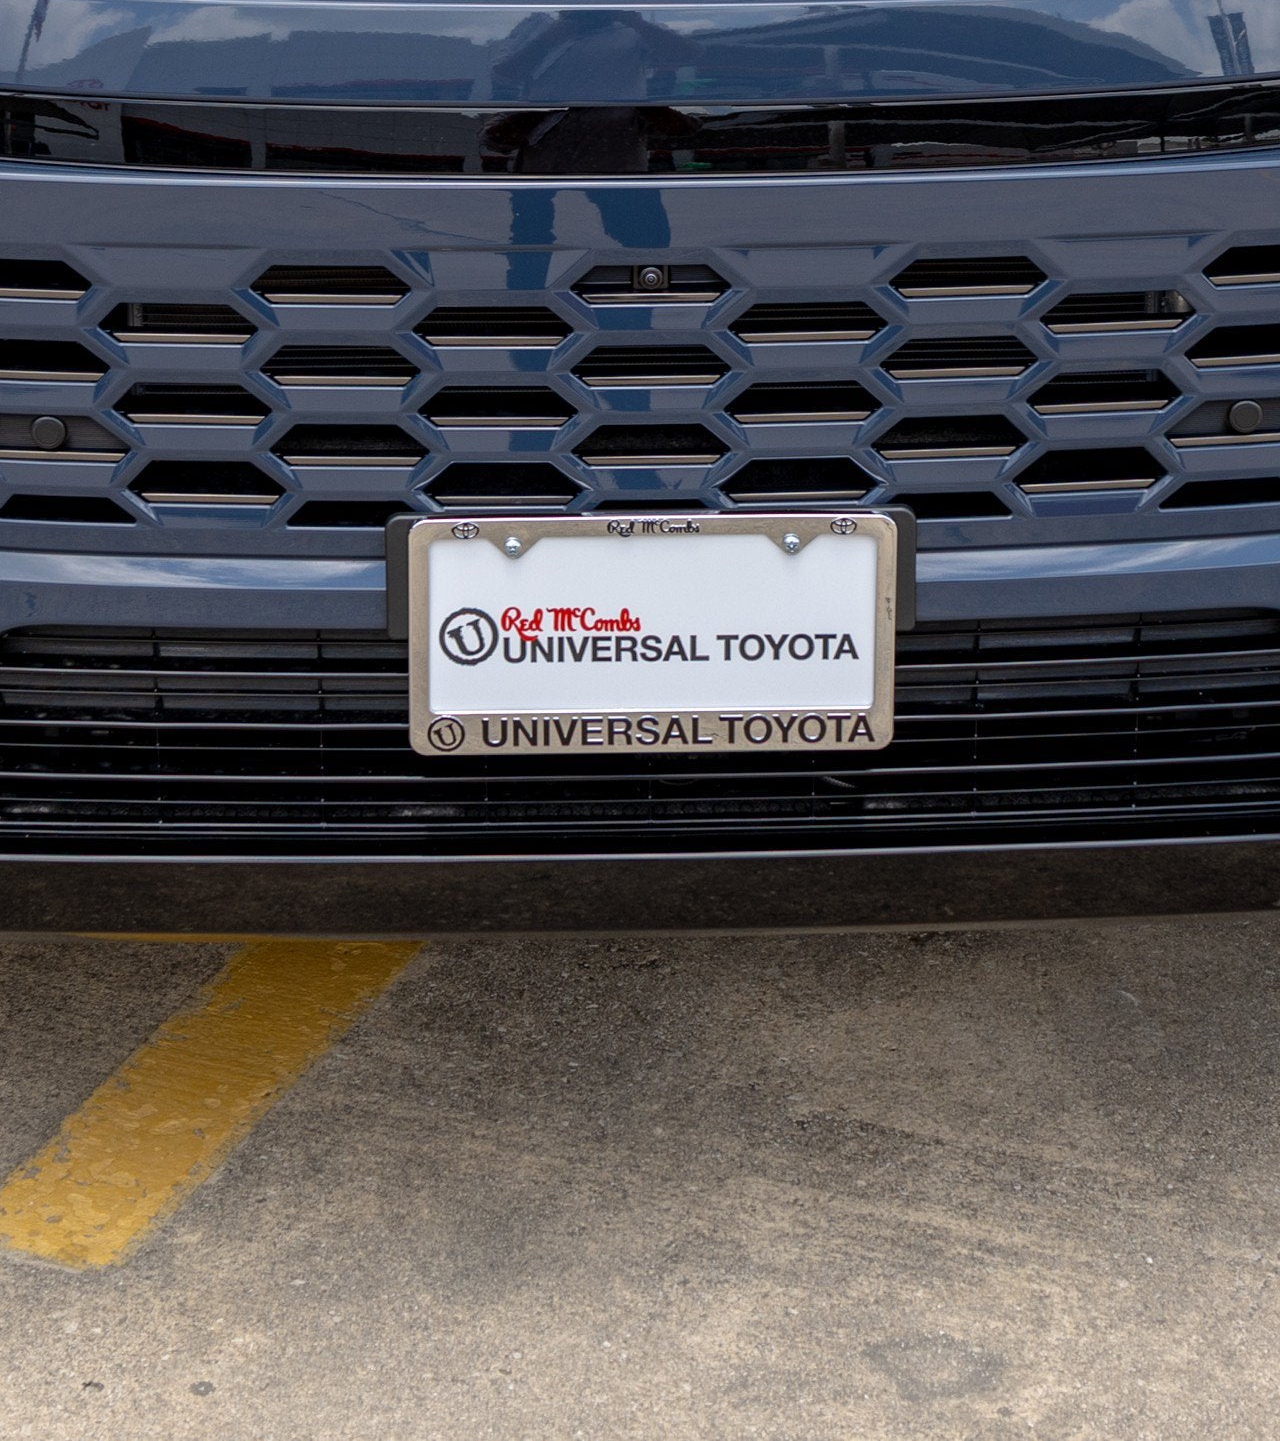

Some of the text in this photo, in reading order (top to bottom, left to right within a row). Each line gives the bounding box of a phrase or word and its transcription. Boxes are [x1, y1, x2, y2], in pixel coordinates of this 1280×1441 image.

[607, 518, 700, 538] Red McCombs
[501, 607, 641, 641] Red McCombs
[503, 633, 859, 663] UNIVERSAL TOYOTA
[481, 712, 875, 747] UNIVERSAL TOYOTA
